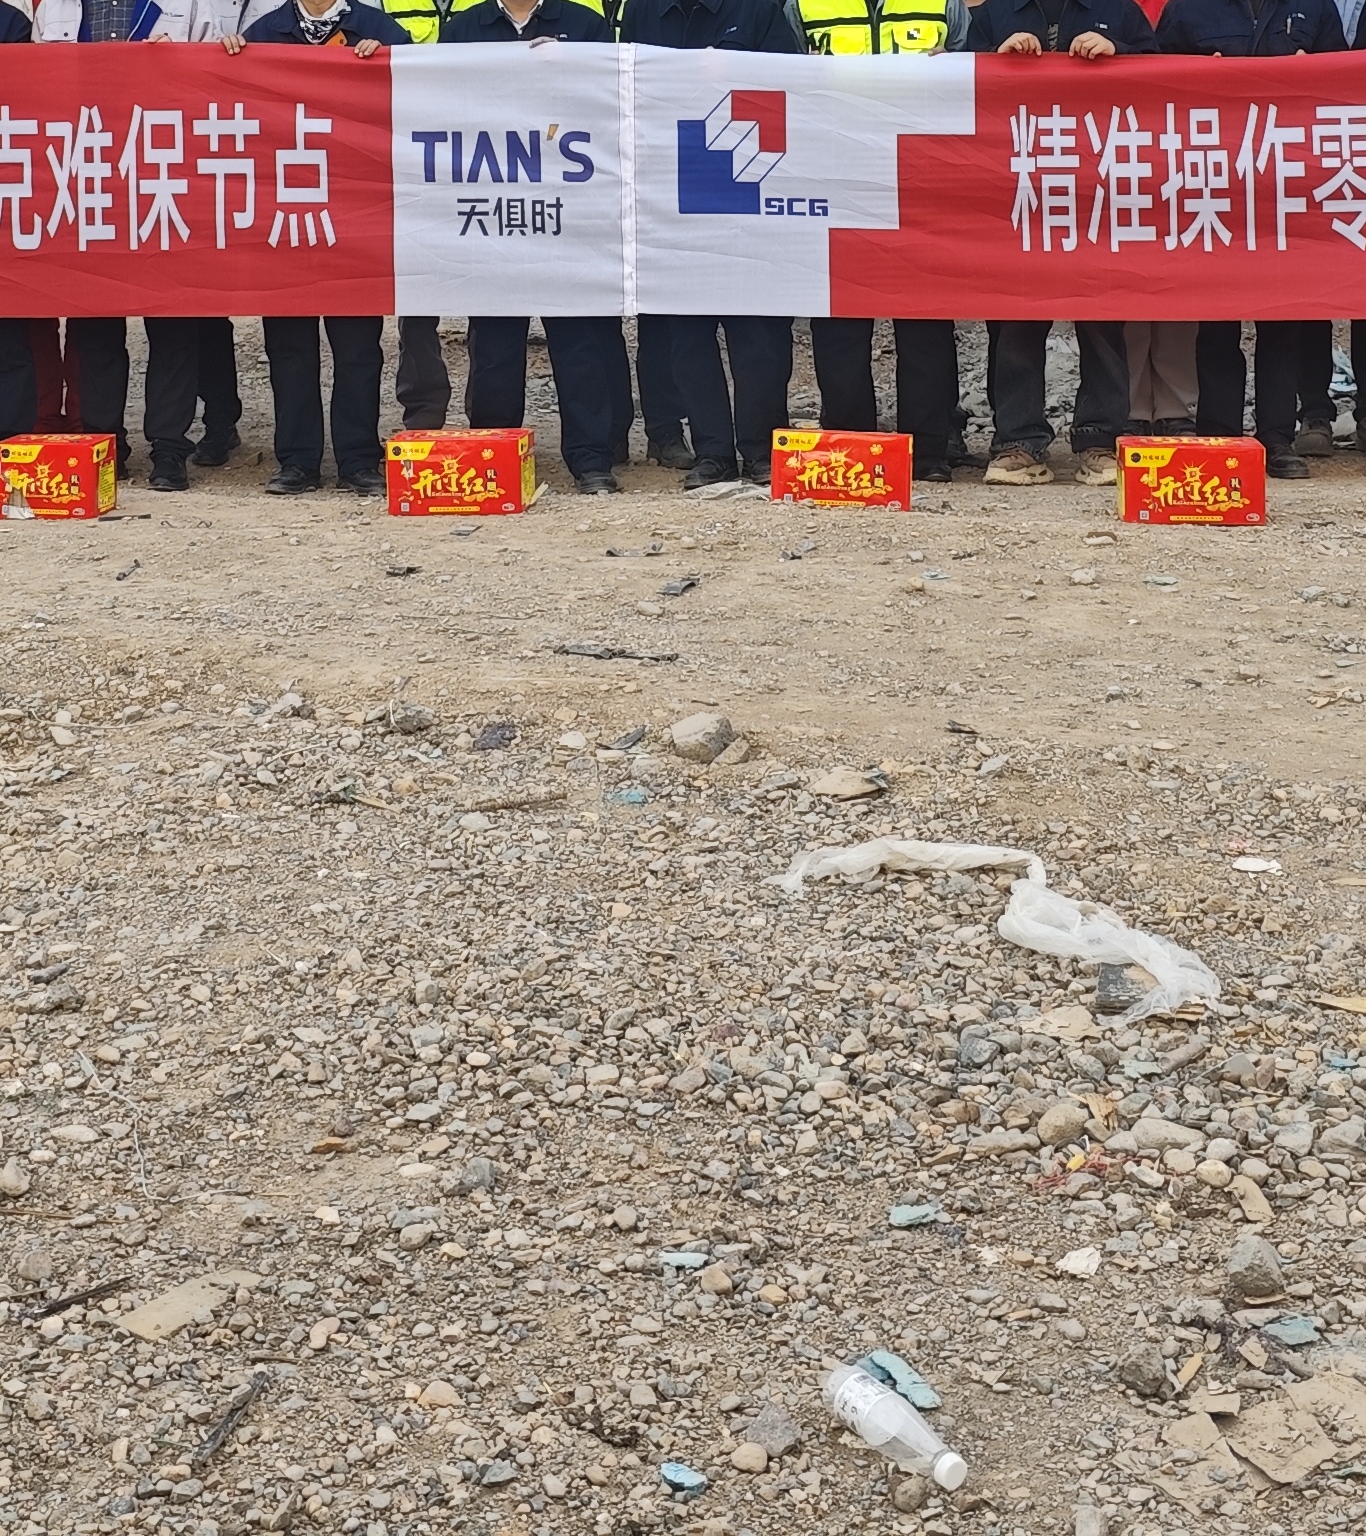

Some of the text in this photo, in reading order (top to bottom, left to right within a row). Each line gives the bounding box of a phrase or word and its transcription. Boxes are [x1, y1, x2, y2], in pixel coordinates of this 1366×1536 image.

[411, 123, 595, 183] TIAN'S
[457, 197, 564, 236] 天俱时
[764, 197, 830, 216] SCG
[411, 458, 485, 499] 开门红
[796, 452, 872, 491] 开门红
[1151, 467, 1229, 507] 开门红
